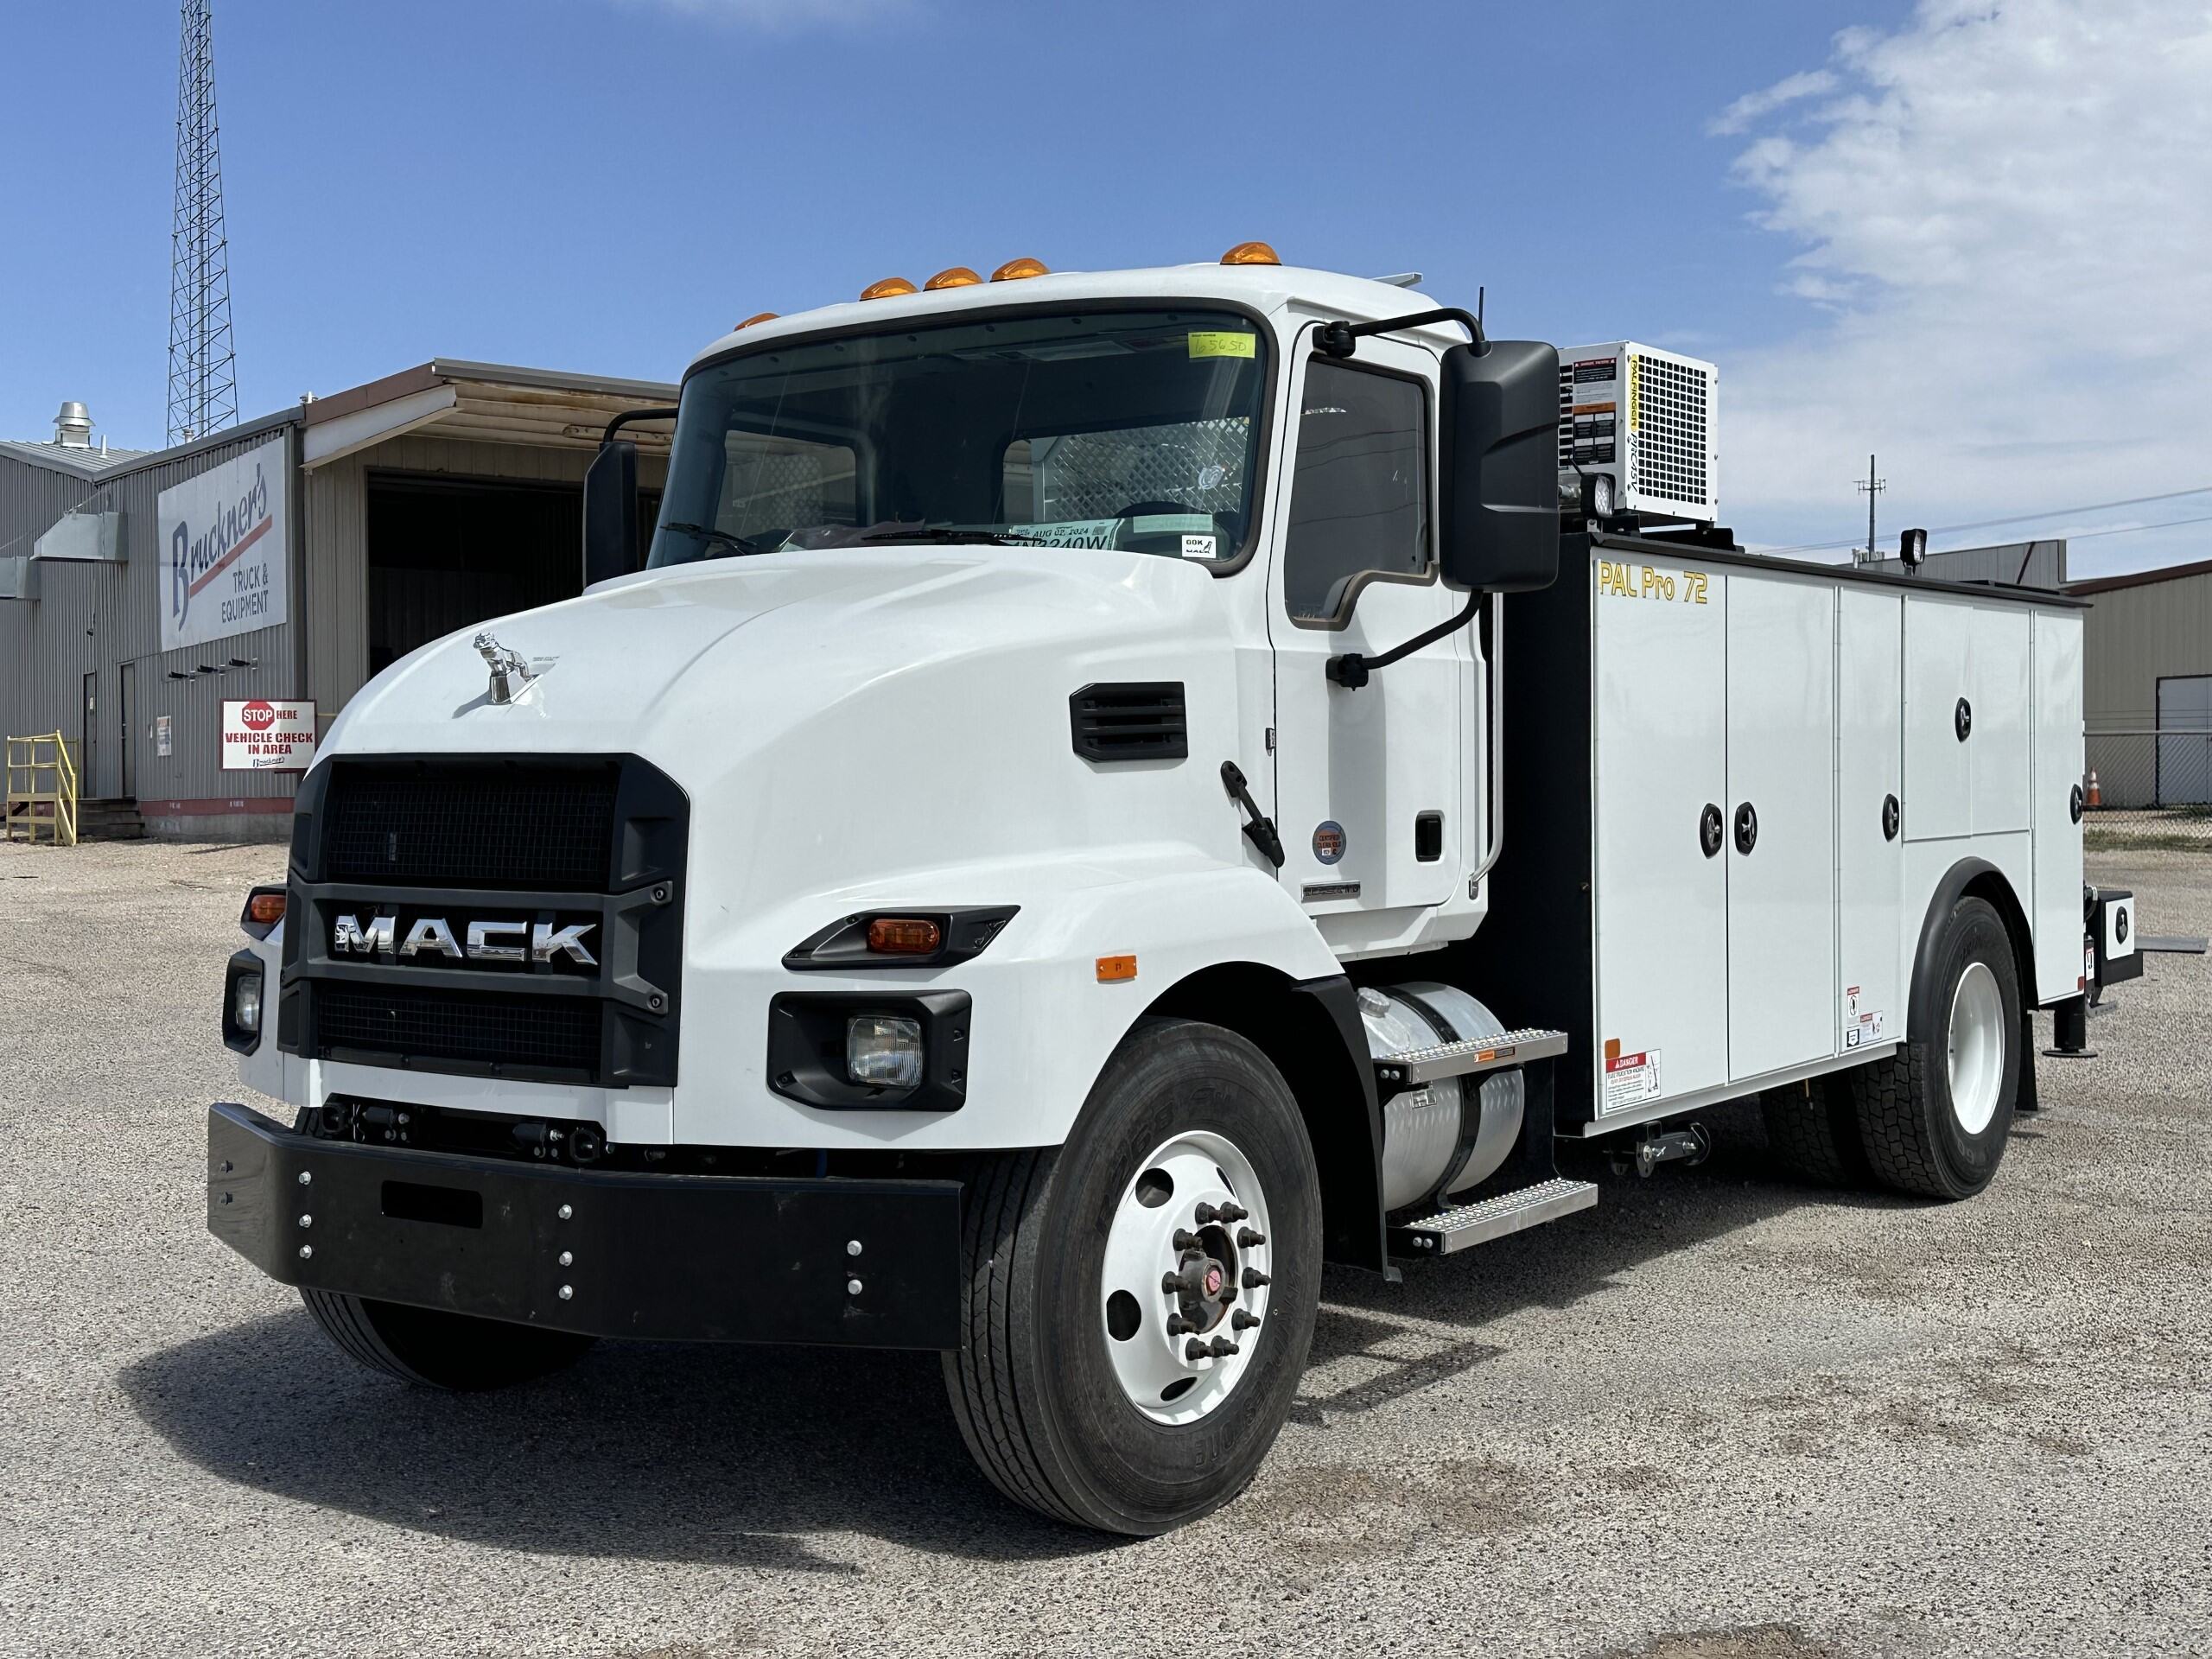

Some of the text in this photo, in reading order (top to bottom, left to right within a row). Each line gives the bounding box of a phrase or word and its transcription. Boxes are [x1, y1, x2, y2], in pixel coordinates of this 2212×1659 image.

[172, 463, 267, 632] Bruckner's
[232, 563, 269, 594] TRUCK &
[1600, 561, 1707, 604] PAL Pro 72
[221, 589, 269, 623] EQUIPMENT
[243, 709, 298, 721] STOP HERE
[225, 732, 313, 743] VEHICLE CHECK
[248, 744, 292, 755] IN AREA
[334, 913, 598, 966] MACK
